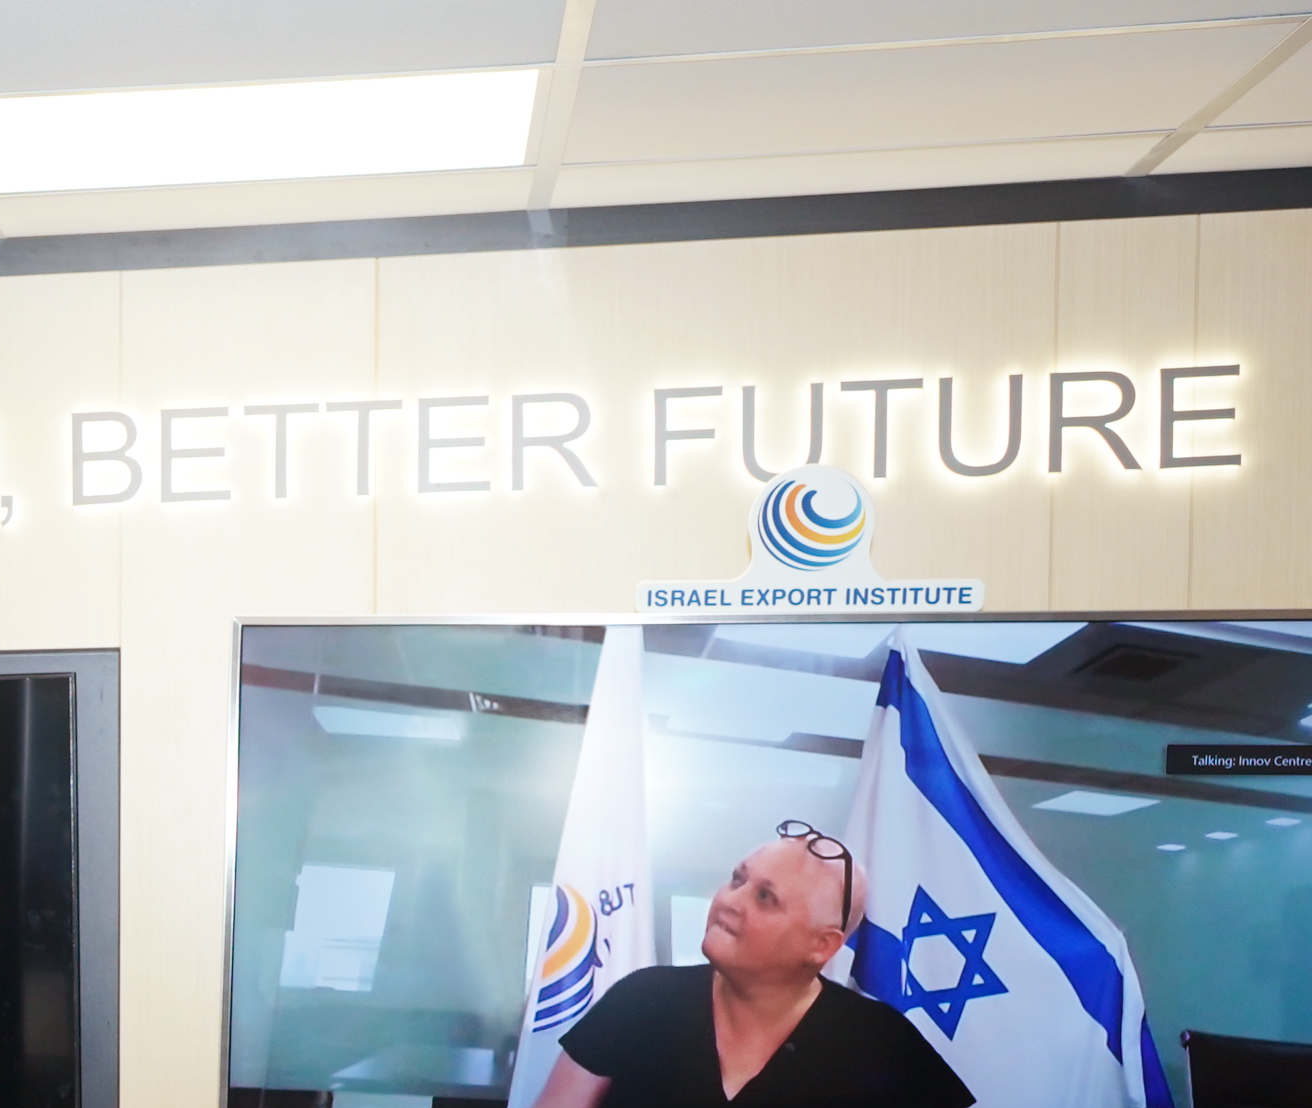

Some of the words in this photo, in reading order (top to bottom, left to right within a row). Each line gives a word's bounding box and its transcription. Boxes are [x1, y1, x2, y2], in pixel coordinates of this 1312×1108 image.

[70, 391, 599, 507] BETTER
[652, 363, 1243, 487] FUTURE
[647, 589, 732, 607] ISRAEL
[741, 588, 837, 607] EXPORT
[846, 586, 973, 606] INSTITUTE
[1192, 755, 1236, 769] Talking:
[1239, 756, 1271, 767] Innov
[1274, 756, 1312, 767] Centre
